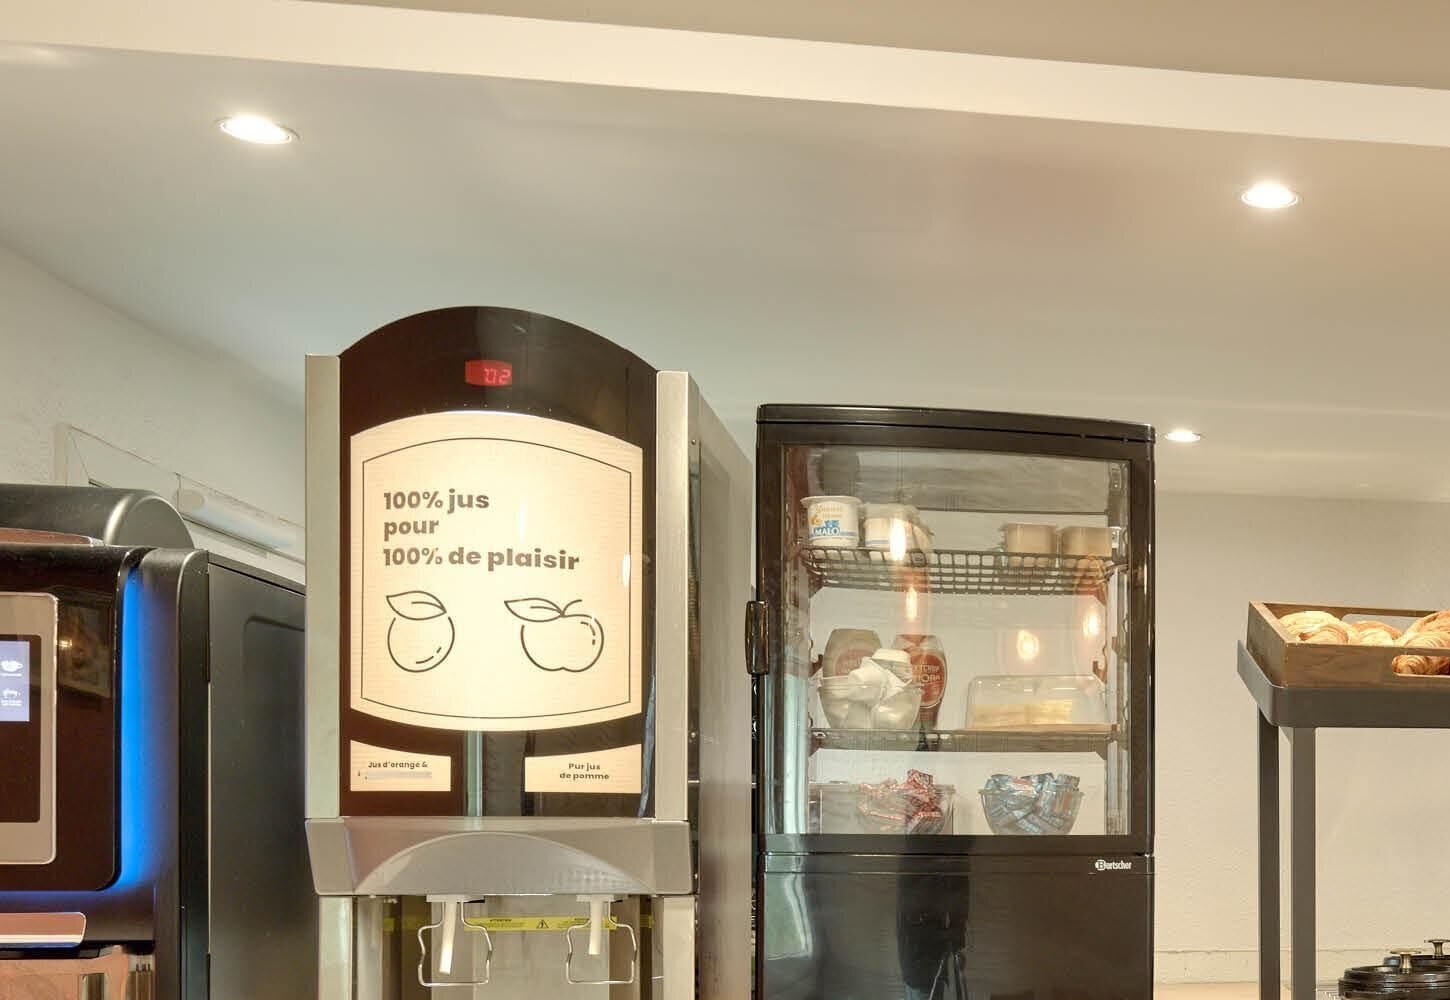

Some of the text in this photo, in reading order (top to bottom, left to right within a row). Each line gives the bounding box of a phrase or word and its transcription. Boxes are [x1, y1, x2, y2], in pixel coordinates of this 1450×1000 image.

[384, 488, 490, 514] 100% jus
[384, 520, 440, 542] pour
[383, 546, 580, 572] 100% de plaisir
[368, 761, 381, 769] Jus
[568, 762, 601, 772] Pur jus
